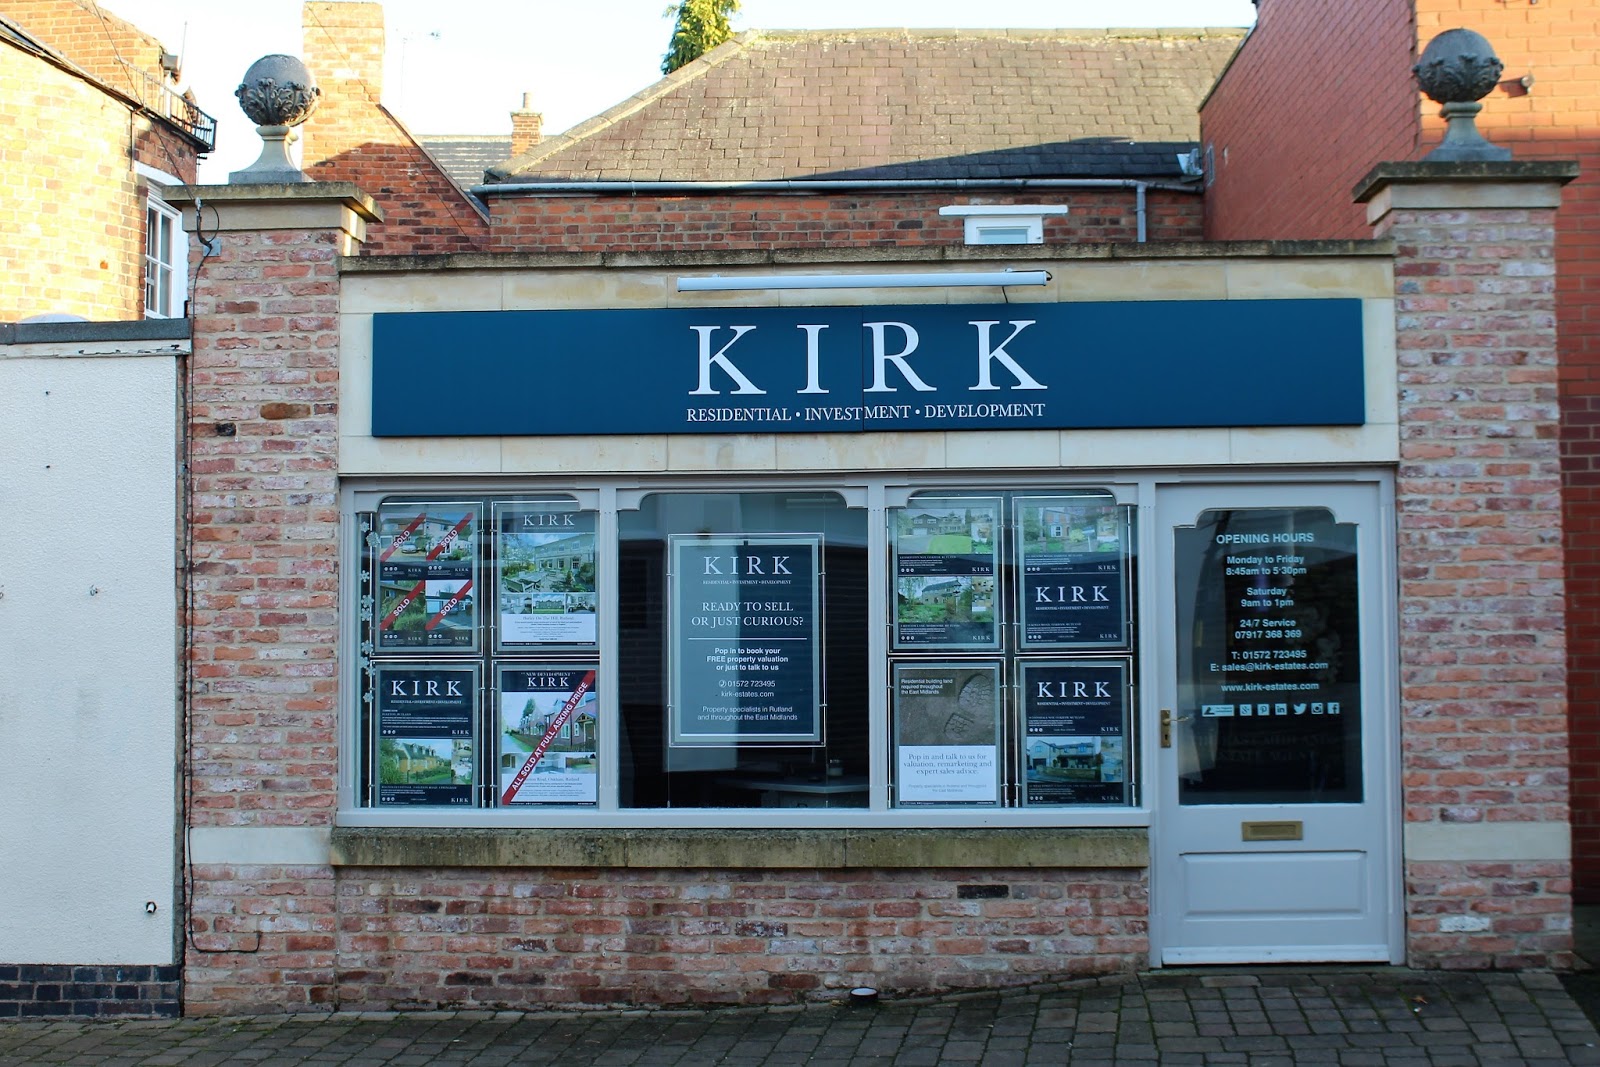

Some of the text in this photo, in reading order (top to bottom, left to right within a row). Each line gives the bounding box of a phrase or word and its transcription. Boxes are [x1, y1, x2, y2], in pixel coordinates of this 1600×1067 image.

[688, 320, 1048, 394] KIRK
[686, 403, 1045, 421] RESIDENTIAL INVESTMENT DEVELOPMENT
[523, 515, 575, 525] KIRK
[393, 530, 410, 548] SOLD
[441, 529, 458, 548] SOLD
[1216, 533, 1314, 544] OPENING HOURS
[703, 556, 792, 574] KIRK
[1227, 556, 1263, 565] Monday
[1276, 555, 1304, 565] Friday
[1035, 585, 1109, 602] KIRK
[1246, 587, 1287, 596] Saturday
[393, 598, 410, 616] SOLD
[441, 598, 457, 616] SOLD
[702, 602, 793, 611] READY TO SELL
[1275, 599, 1294, 608] 1pm
[692, 616, 803, 628] OR JUST CURIOUS?
[1240, 619, 1296, 628] 24/7 Service
[1235, 630, 1302, 639] 07917 368 369
[1243, 651, 1270, 659] 01572
[1273, 650, 1307, 658] 723495
[1222, 662, 1328, 672] sales@kirk-estates.com
[528, 677, 569, 686] KIRK
[1221, 682, 1319, 691] www.kirk-estates.com
[391, 680, 462, 696] KIRK
[1037, 681, 1111, 698] KIRK
[512, 776, 524, 790] ALL
[520, 757, 536, 776] SOLD
[534, 747, 544, 759] AT
[540, 731, 555, 749] FULL
[553, 704, 573, 731] ASKING
[570, 681, 588, 705] PRICE
